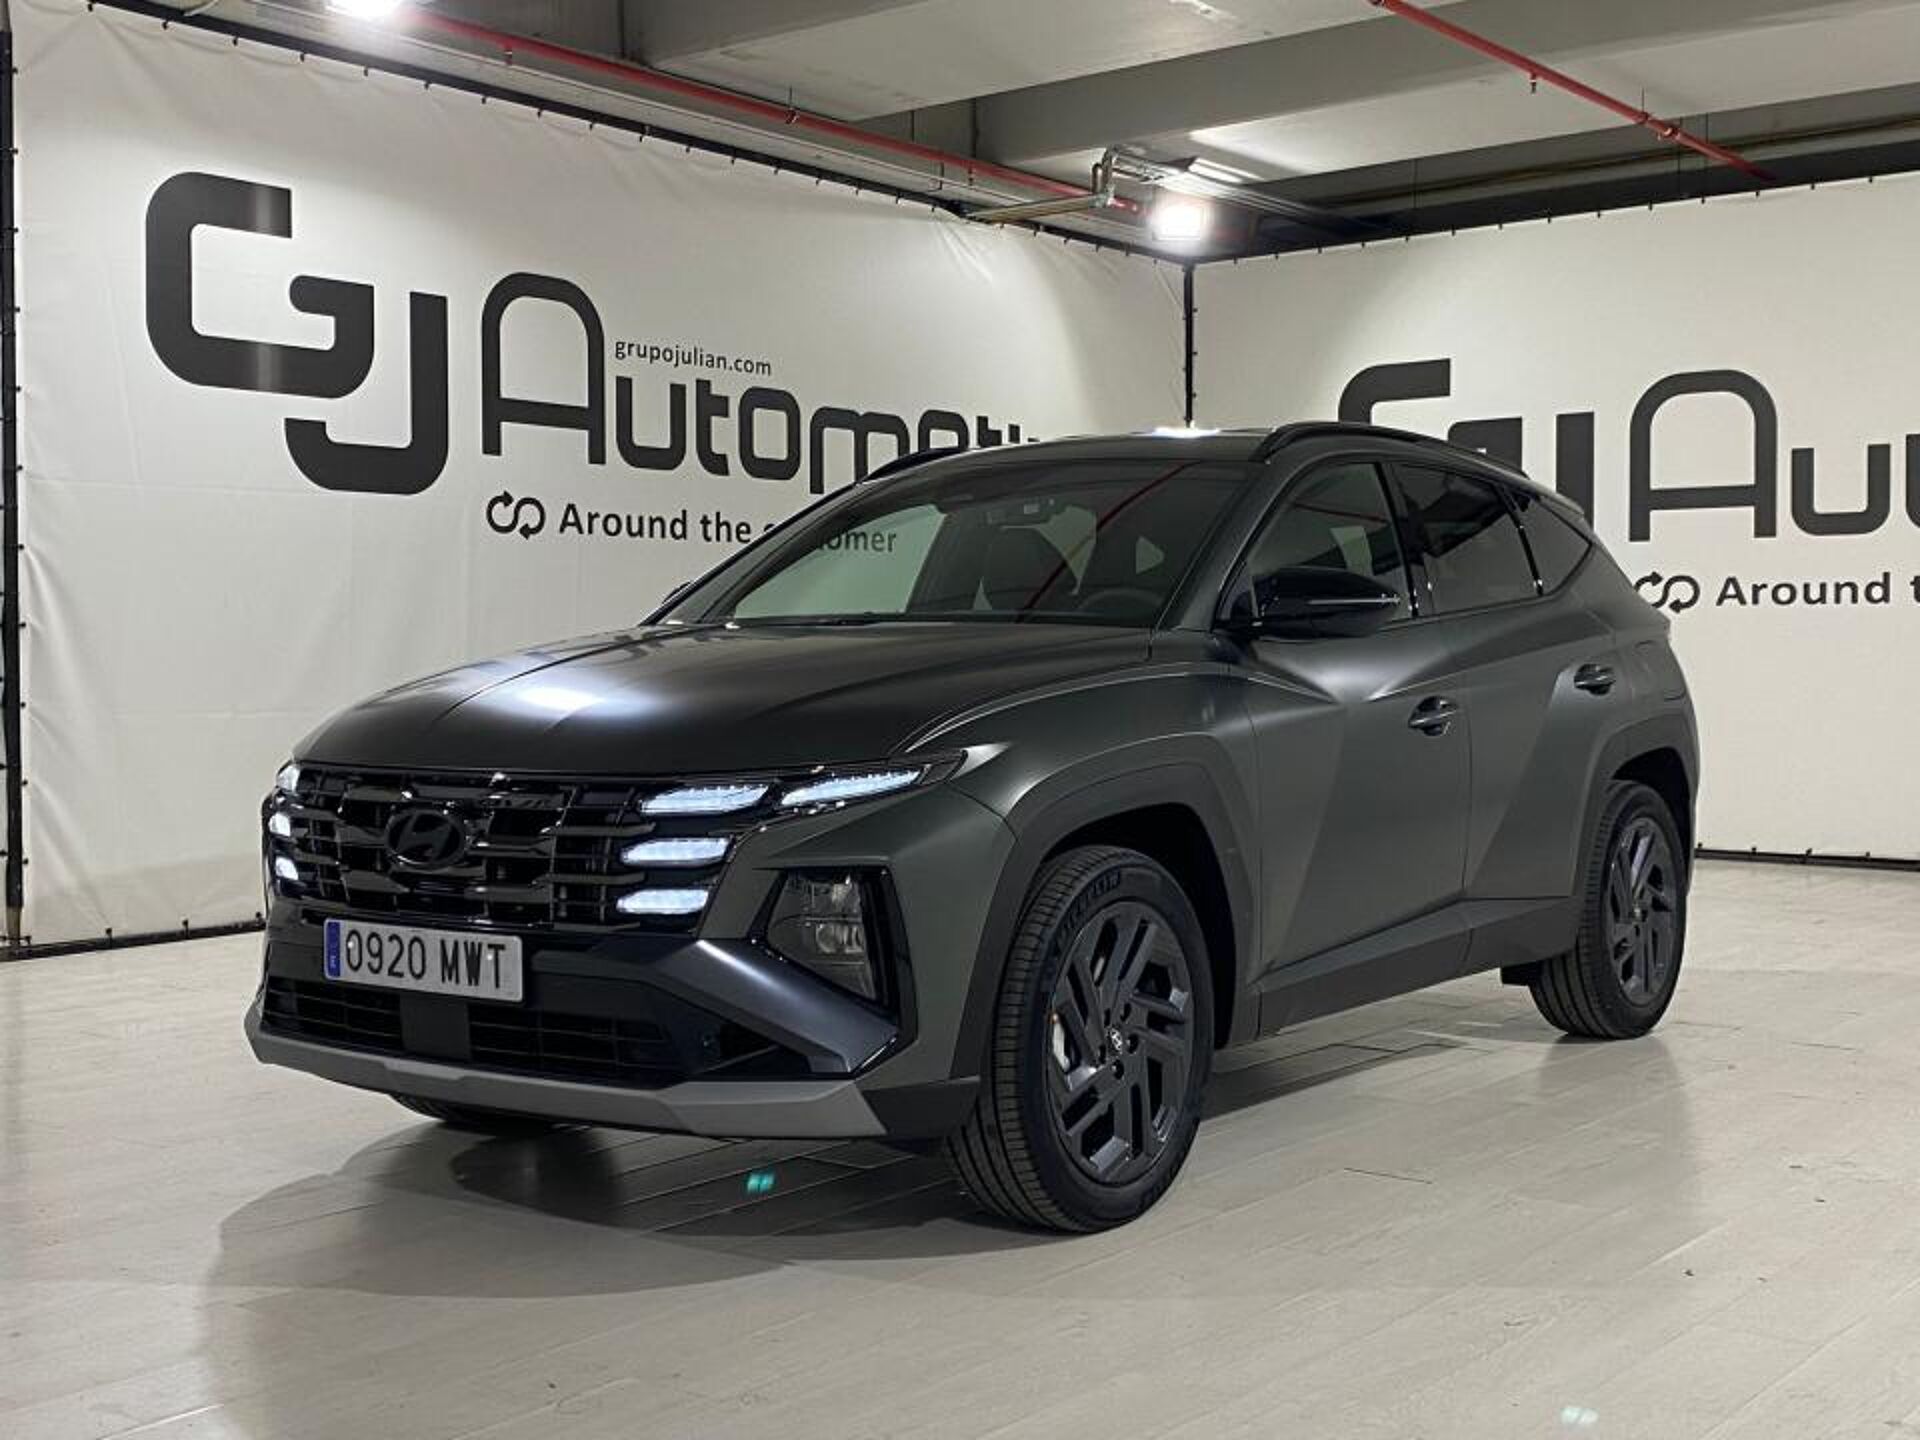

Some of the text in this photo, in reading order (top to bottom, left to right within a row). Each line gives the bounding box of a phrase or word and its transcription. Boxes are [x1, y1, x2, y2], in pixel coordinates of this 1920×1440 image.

[145, 171, 449, 495] GJ
[615, 341, 772, 376] grupojulian.com
[559, 502, 688, 541] Around
[700, 511, 751, 543] the
[1716, 571, 1891, 605] Around
[346, 929, 506, 989] 0920 MWT
